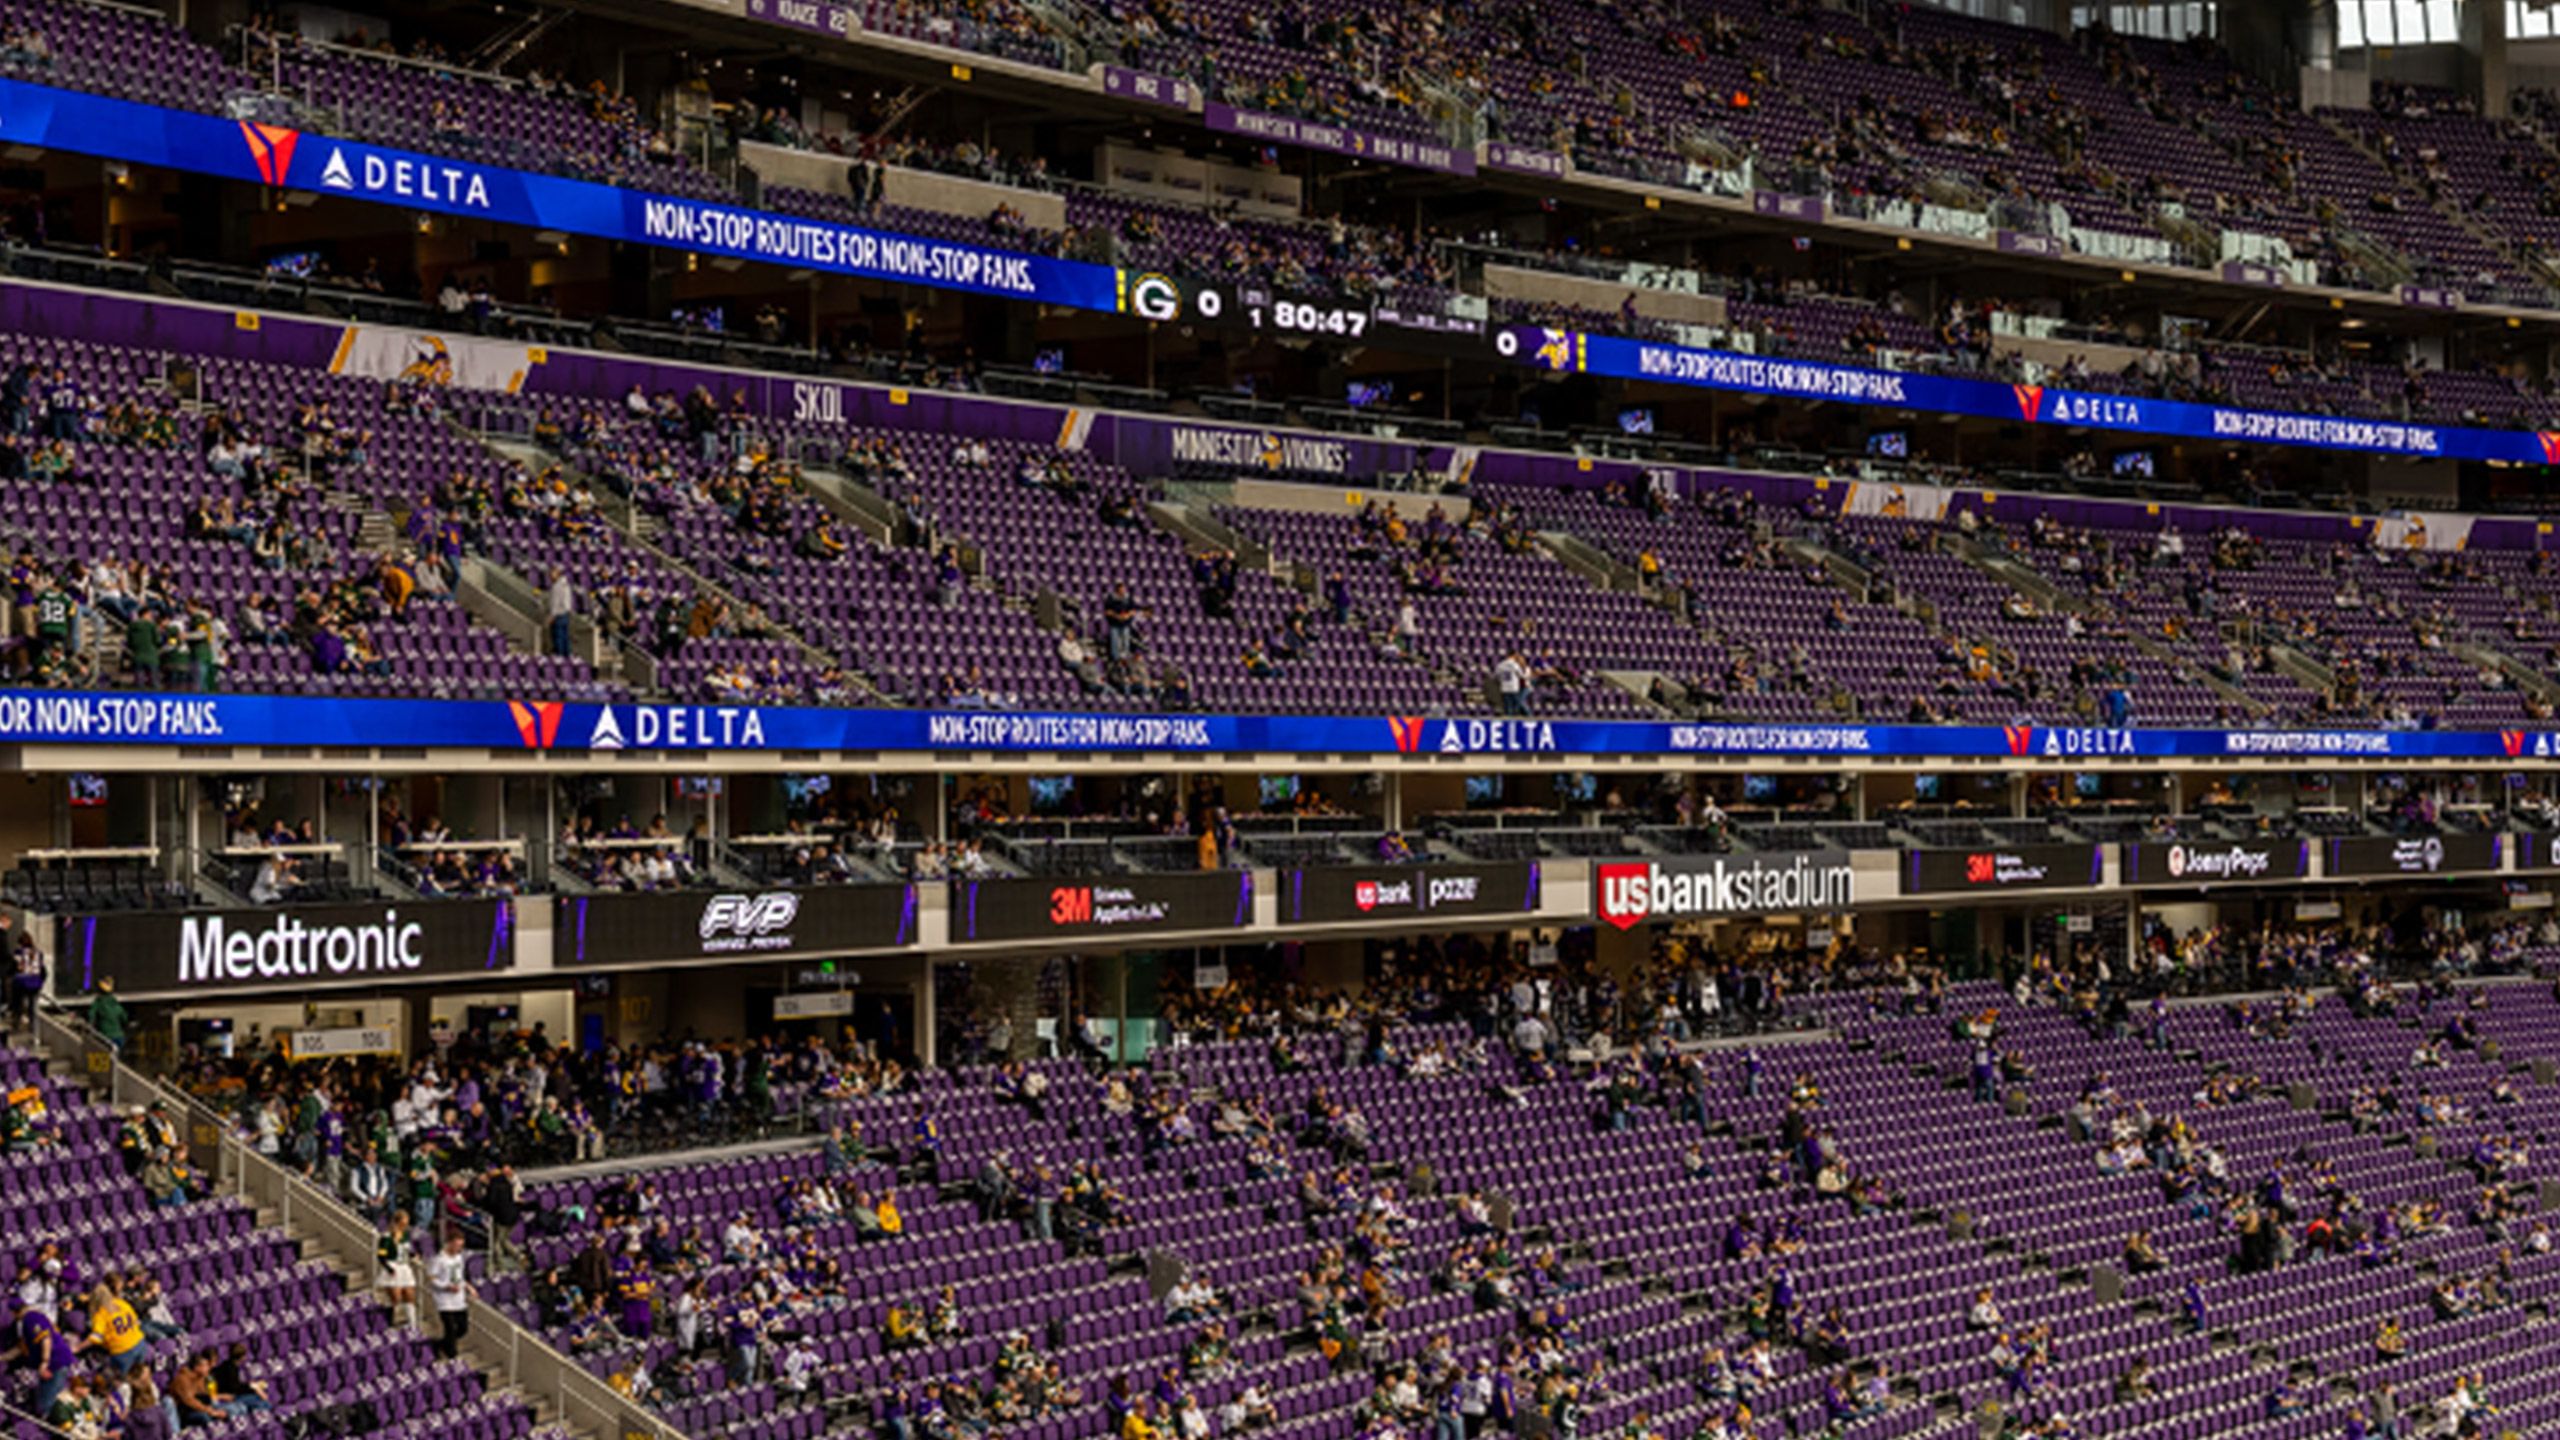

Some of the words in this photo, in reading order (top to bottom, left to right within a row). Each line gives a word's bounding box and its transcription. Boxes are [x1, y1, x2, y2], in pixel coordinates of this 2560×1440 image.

[365, 153, 490, 208] DELTA
[645, 198, 754, 250] NON-STOP
[756, 218, 836, 263] ROUTES
[838, 230, 877, 269] FOR
[880, 238, 980, 284] NON-STOP
[982, 253, 1036, 293] FANS.
[1198, 289, 1221, 317] 0
[1250, 308, 1262, 328] 1
[1274, 300, 1367, 337] 80:47
[1496, 330, 1518, 356] 0
[1640, 346, 1712, 380] NON-STOP
[1713, 355, 1766, 388] ROUTES
[1794, 366, 1867, 397] NON-STOP
[793, 381, 848, 423] SKOL
[2073, 397, 2140, 424] DELTA
[1171, 427, 1264, 466] MINNESOTA
[1282, 437, 1345, 474] VIKINGS
[36, 697, 157, 735] NON-STOP
[160, 701, 223, 735] FANS.
[636, 706, 765, 746] DELTA
[929, 715, 1010, 743] NON-STOP
[1011, 716, 1070, 744] ROUTES
[1071, 717, 1098, 744] FOR
[1100, 718, 1171, 745] NON-STOP
[1468, 719, 1556, 750] DELTA
[2066, 728, 2136, 754] DELTA
[1967, 853, 1994, 882] 3M
[2186, 847, 2269, 877] JonnyPops
[700, 891, 798, 939] FVP
[1050, 886, 1091, 924] 3M
[178, 908, 423, 982] Medtronic
